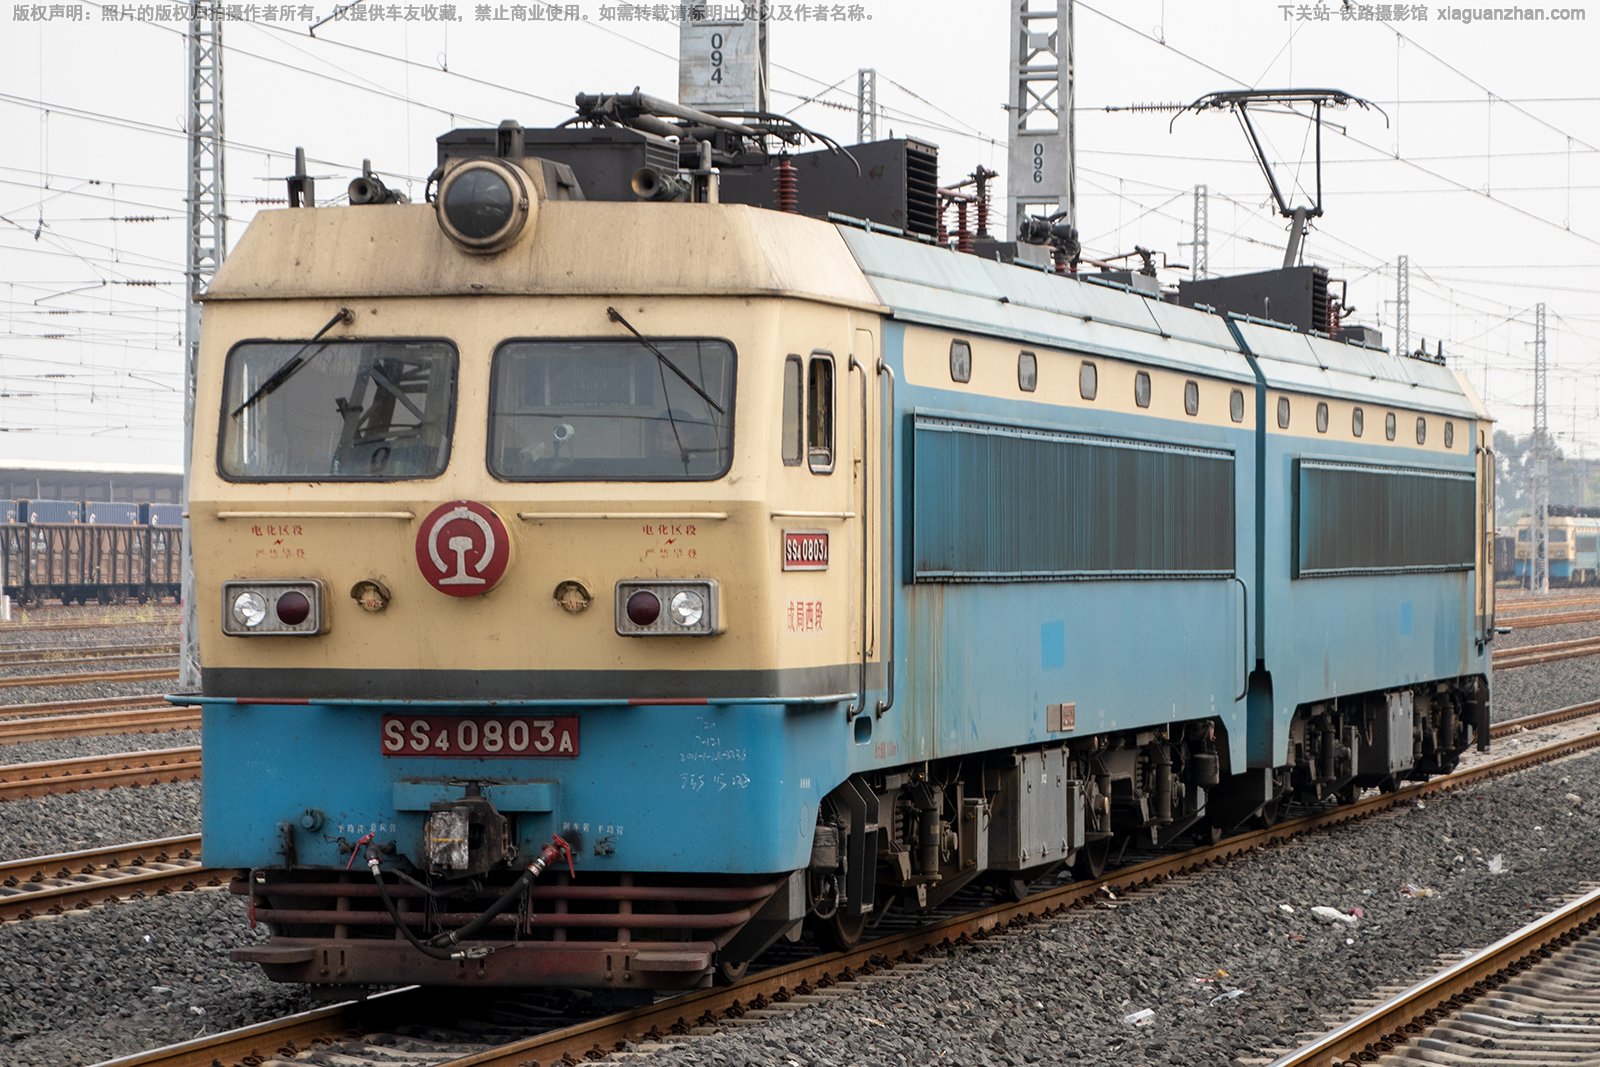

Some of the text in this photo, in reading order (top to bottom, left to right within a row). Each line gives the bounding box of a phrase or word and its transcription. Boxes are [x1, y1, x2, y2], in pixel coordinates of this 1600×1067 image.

[711, 33, 723, 84] 094
[1033, 143, 1044, 183] 096
[787, 601, 823, 632] 成局西段
